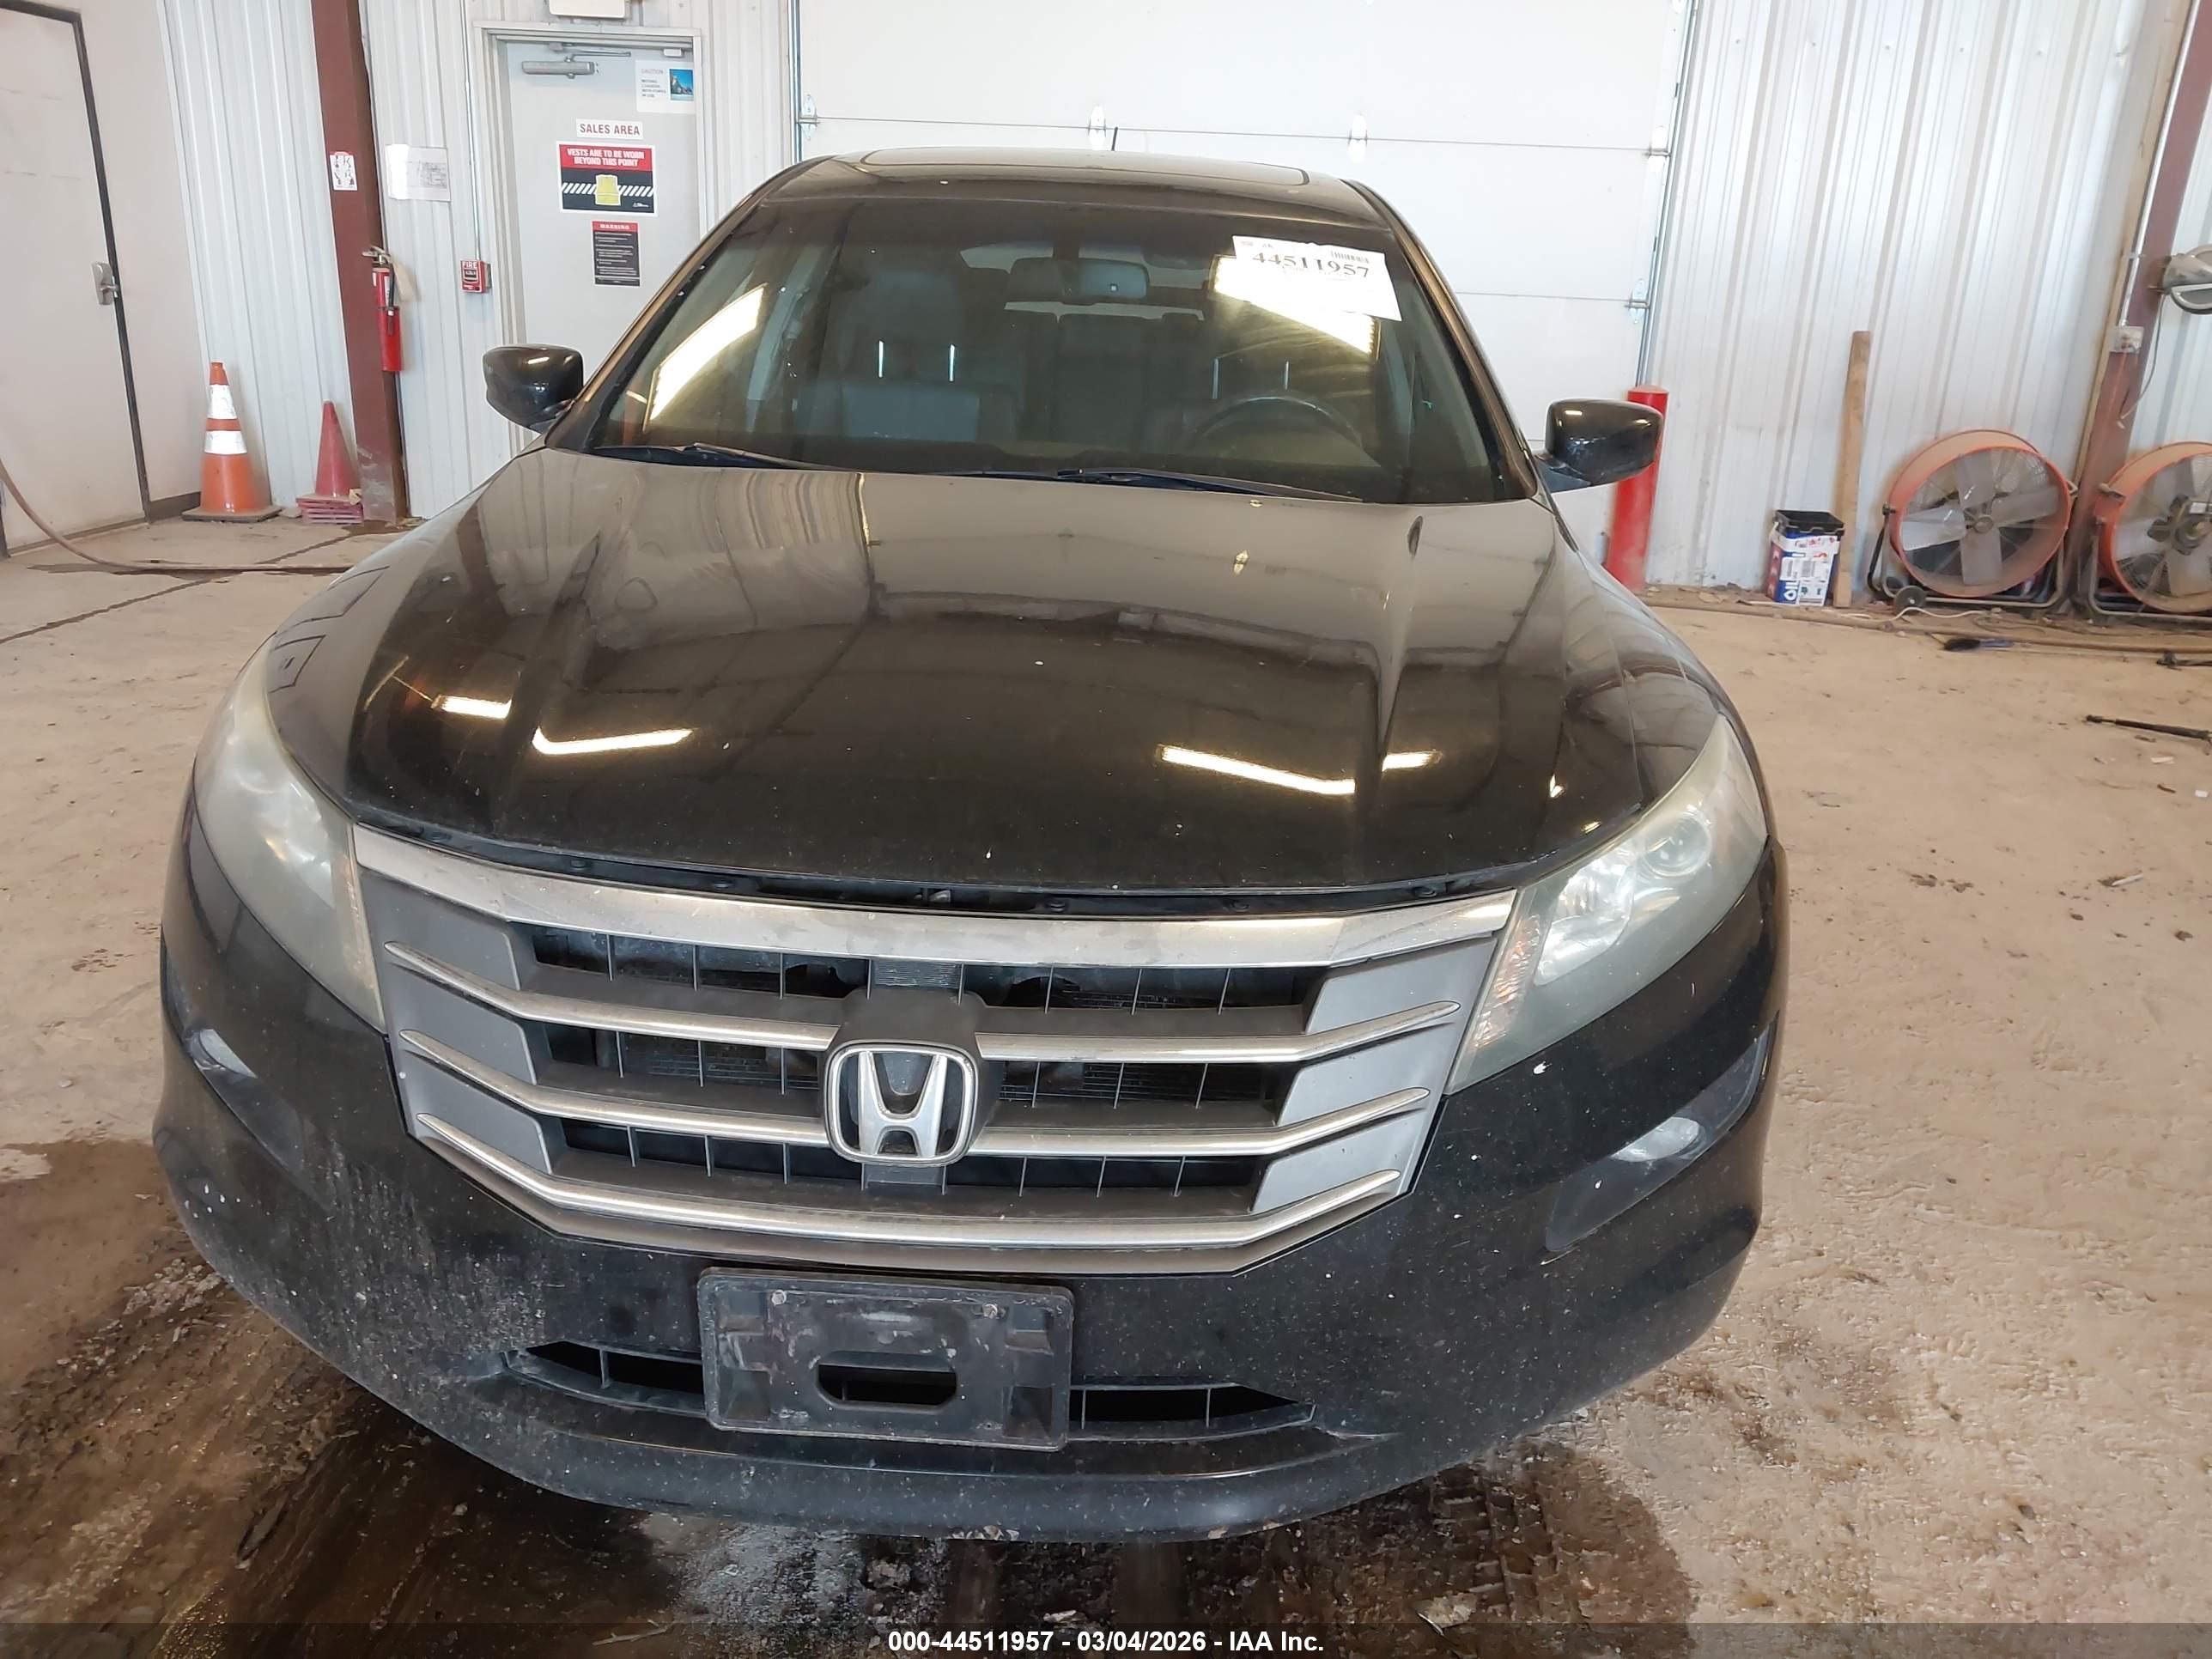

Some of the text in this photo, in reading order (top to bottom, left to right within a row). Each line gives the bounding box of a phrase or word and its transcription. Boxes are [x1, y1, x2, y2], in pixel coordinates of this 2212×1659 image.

[579, 123, 641, 136] SALES AREA
[567, 148, 588, 156] VESTS
[574, 156, 639, 167] BEYOND THIS POINT
[462, 260, 477, 269] FIRE
[1252, 252, 1370, 278] 44511957
